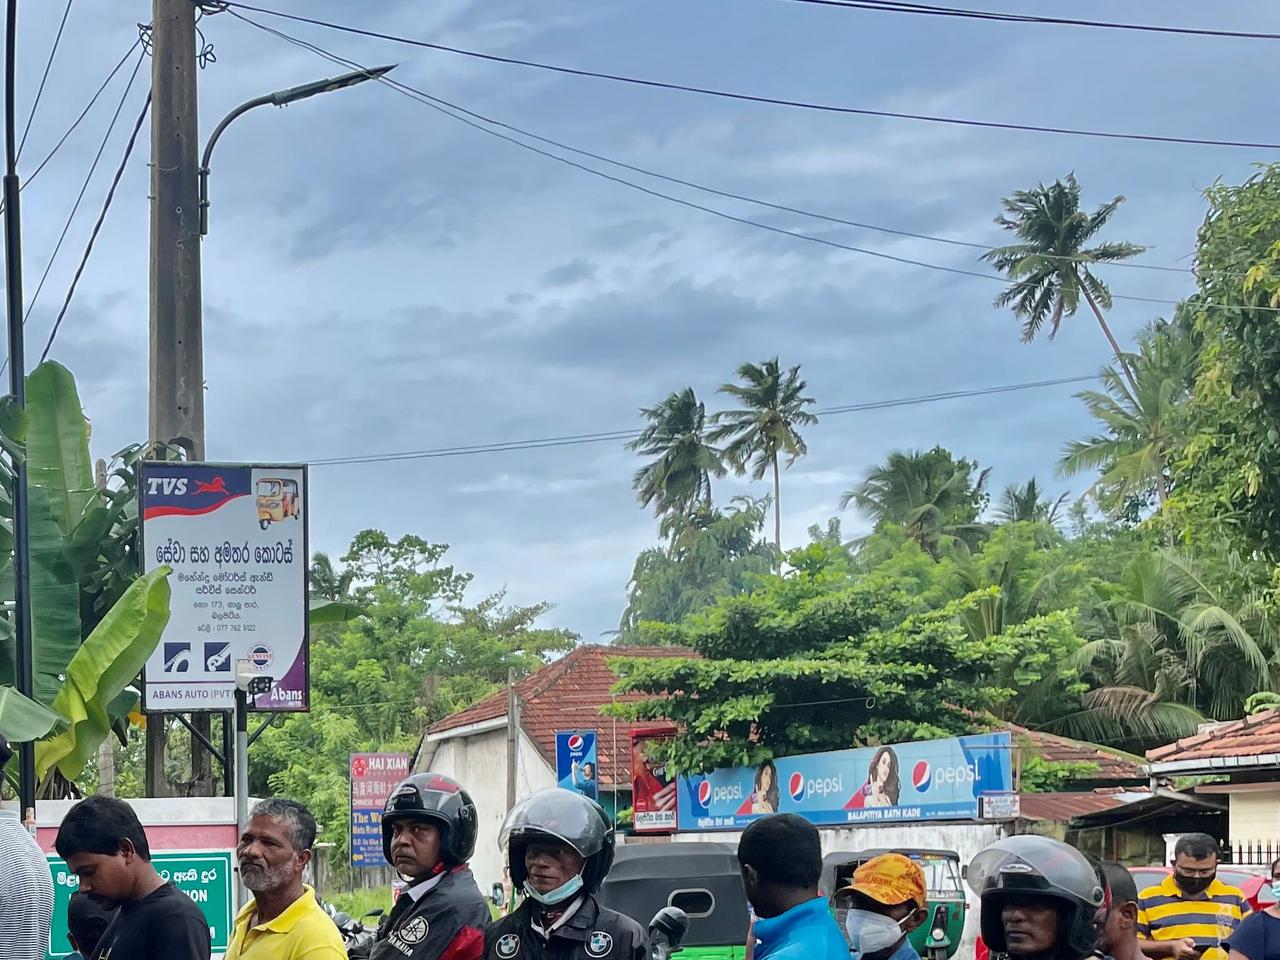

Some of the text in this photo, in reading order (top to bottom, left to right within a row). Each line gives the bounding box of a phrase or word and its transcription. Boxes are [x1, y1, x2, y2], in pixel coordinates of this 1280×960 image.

[148, 478, 188, 495] TVS
[190, 544, 209, 563] සහ
[153, 690, 183, 699] ABANS
[185, 690, 208, 699] AUTO
[271, 688, 302, 701] Abans
[369, 757, 407, 769] HAI XIAN
[935, 760, 980, 788] pepsi
[713, 783, 743, 804] pepsi
[807, 773, 843, 798] pepsi
[352, 812, 369, 823] The
[848, 810, 883, 821] BALAPITIYA
[884, 808, 901, 818] BATH
[902, 807, 921, 817] KADE
[387, 931, 414, 958] YAMAHA
